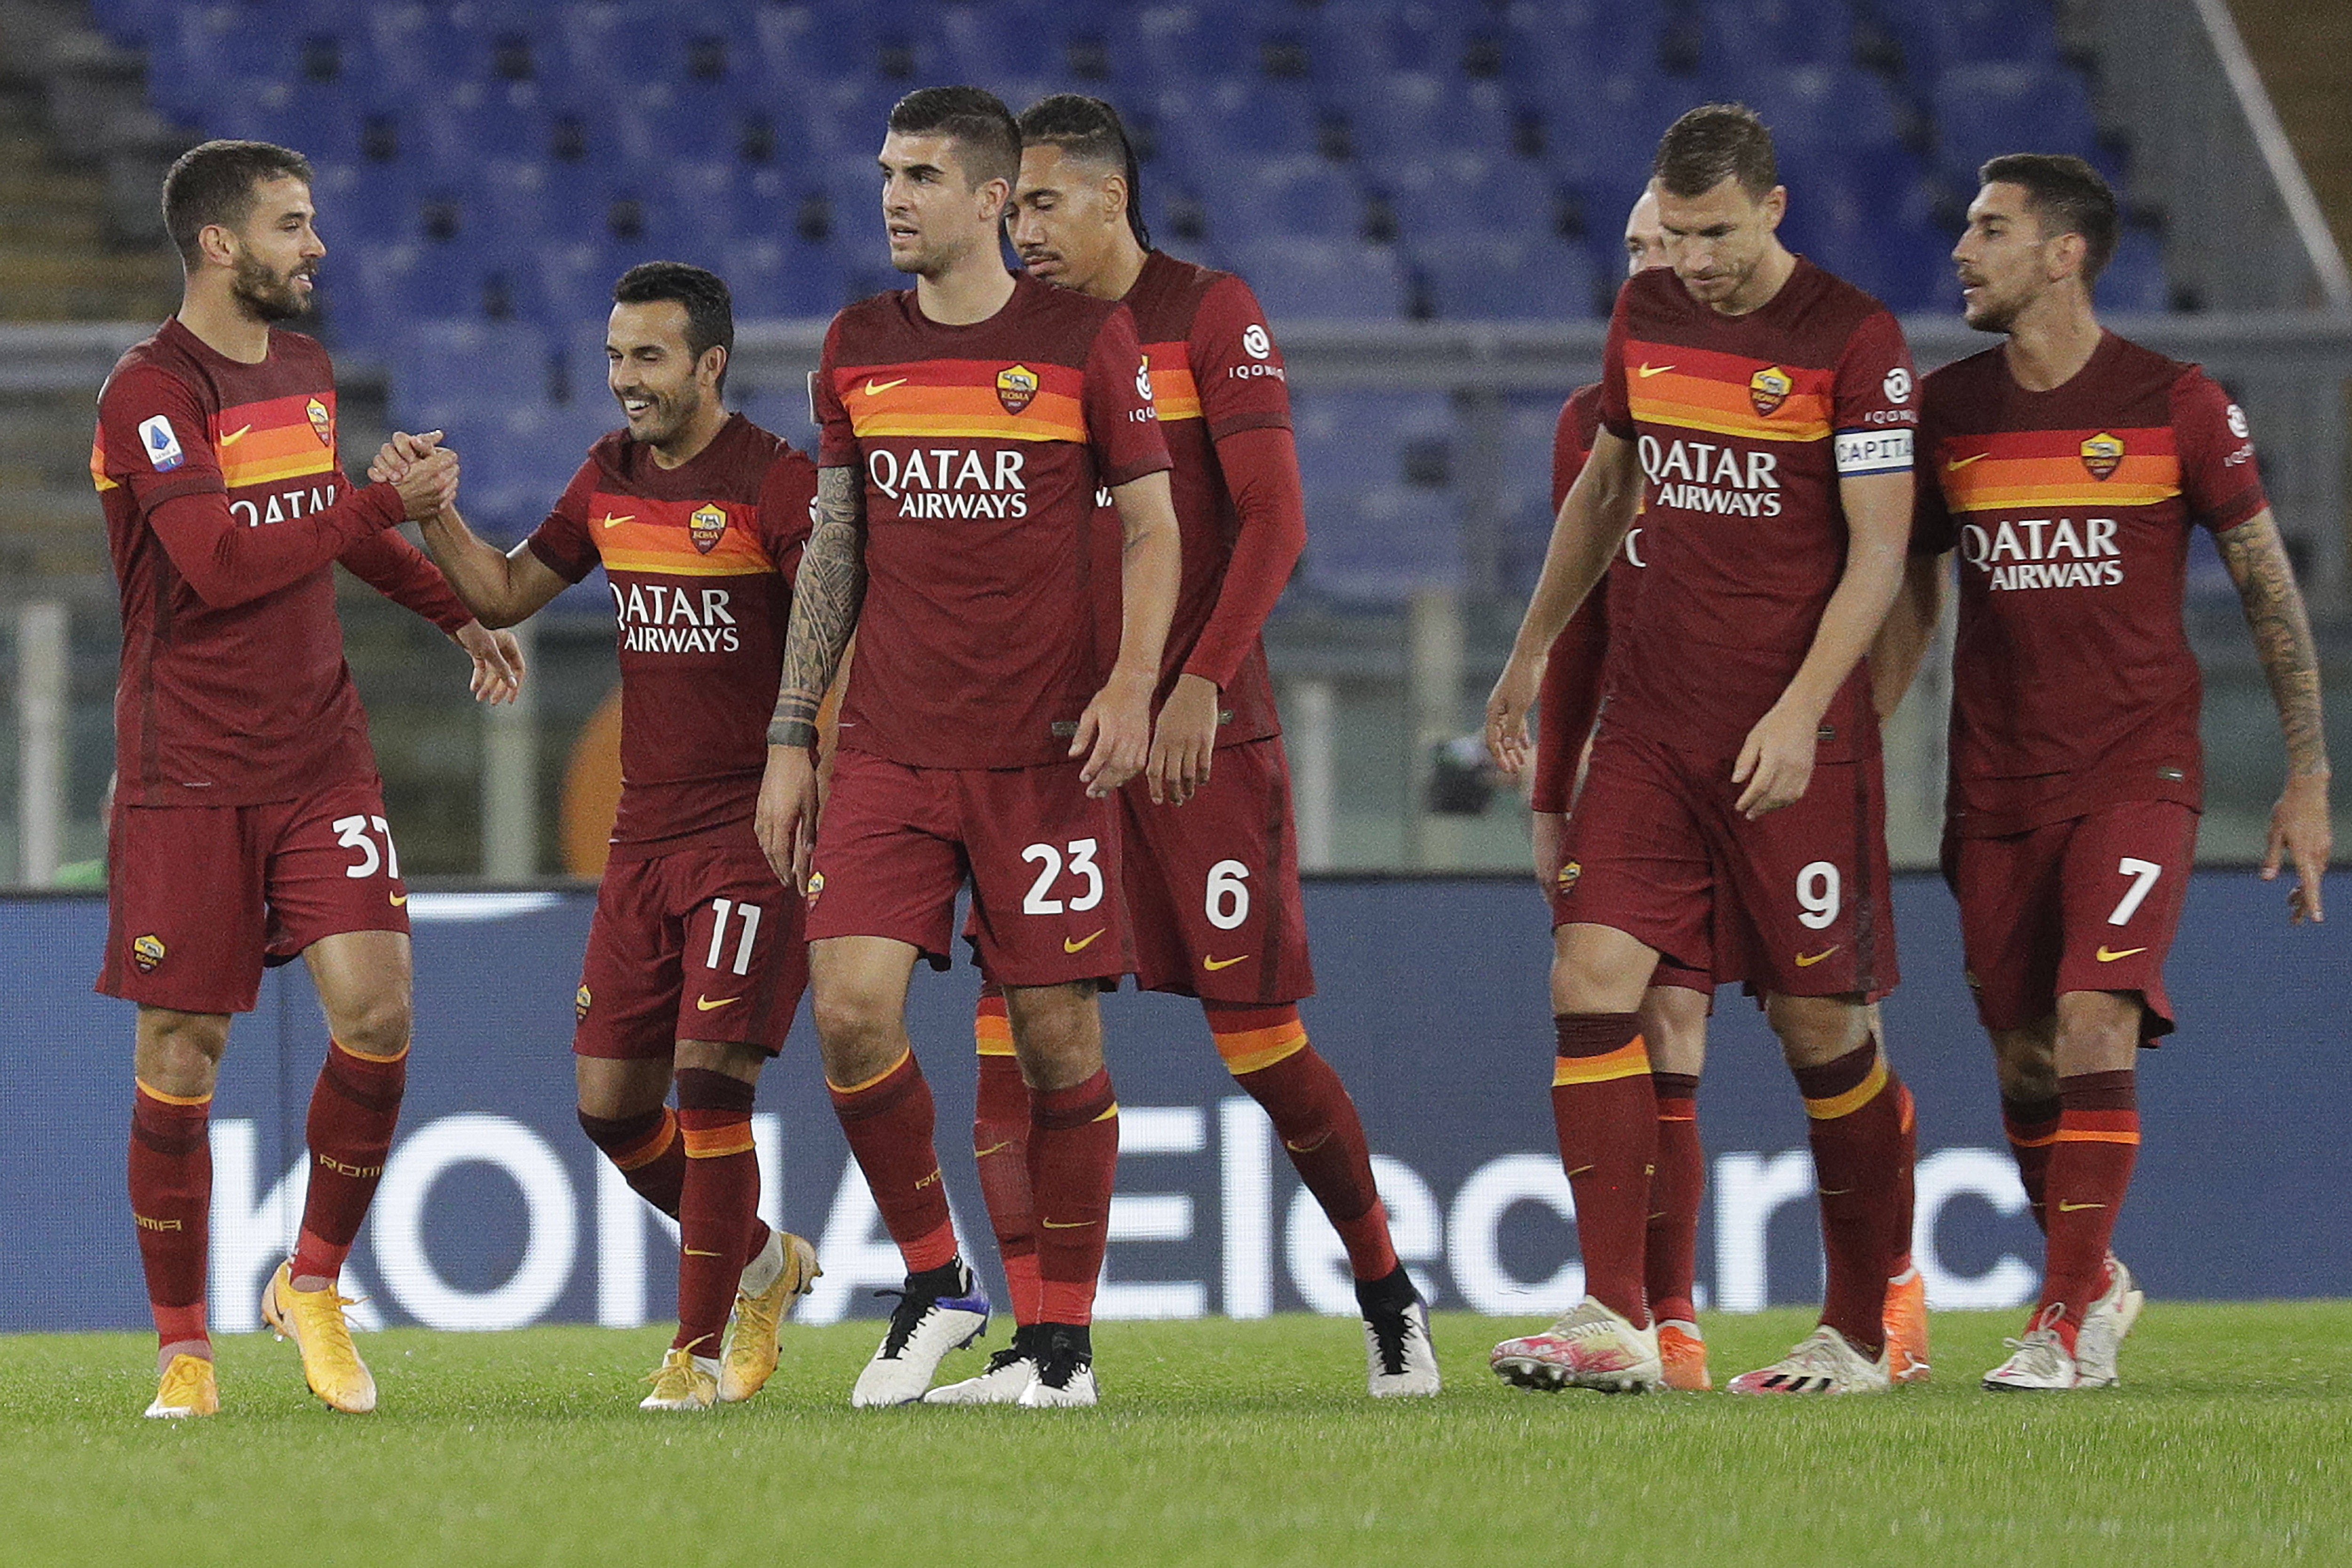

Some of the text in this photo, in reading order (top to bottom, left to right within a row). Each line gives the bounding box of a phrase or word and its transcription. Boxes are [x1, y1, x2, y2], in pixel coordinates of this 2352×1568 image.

[870, 449, 1025, 499] QATAR
[1638, 435, 1780, 489] QATAR
[899, 492, 1027, 518] AIRWAYS
[1656, 483, 1781, 517] AIRWAYS
[1961, 518, 2121, 572] QATAR
[1990, 560, 2124, 591] AIRWAYS
[624, 625, 739, 653] AIRWAYS
[1021, 838, 1103, 915] 23
[1205, 860, 1249, 930] 6
[1796, 861, 1840, 929] 9
[2107, 858, 2161, 925] 7
[707, 898, 761, 975] 11
[319, 1153, 385, 1178] ROM
[1091, 1095, 2042, 1320] Elecrc
